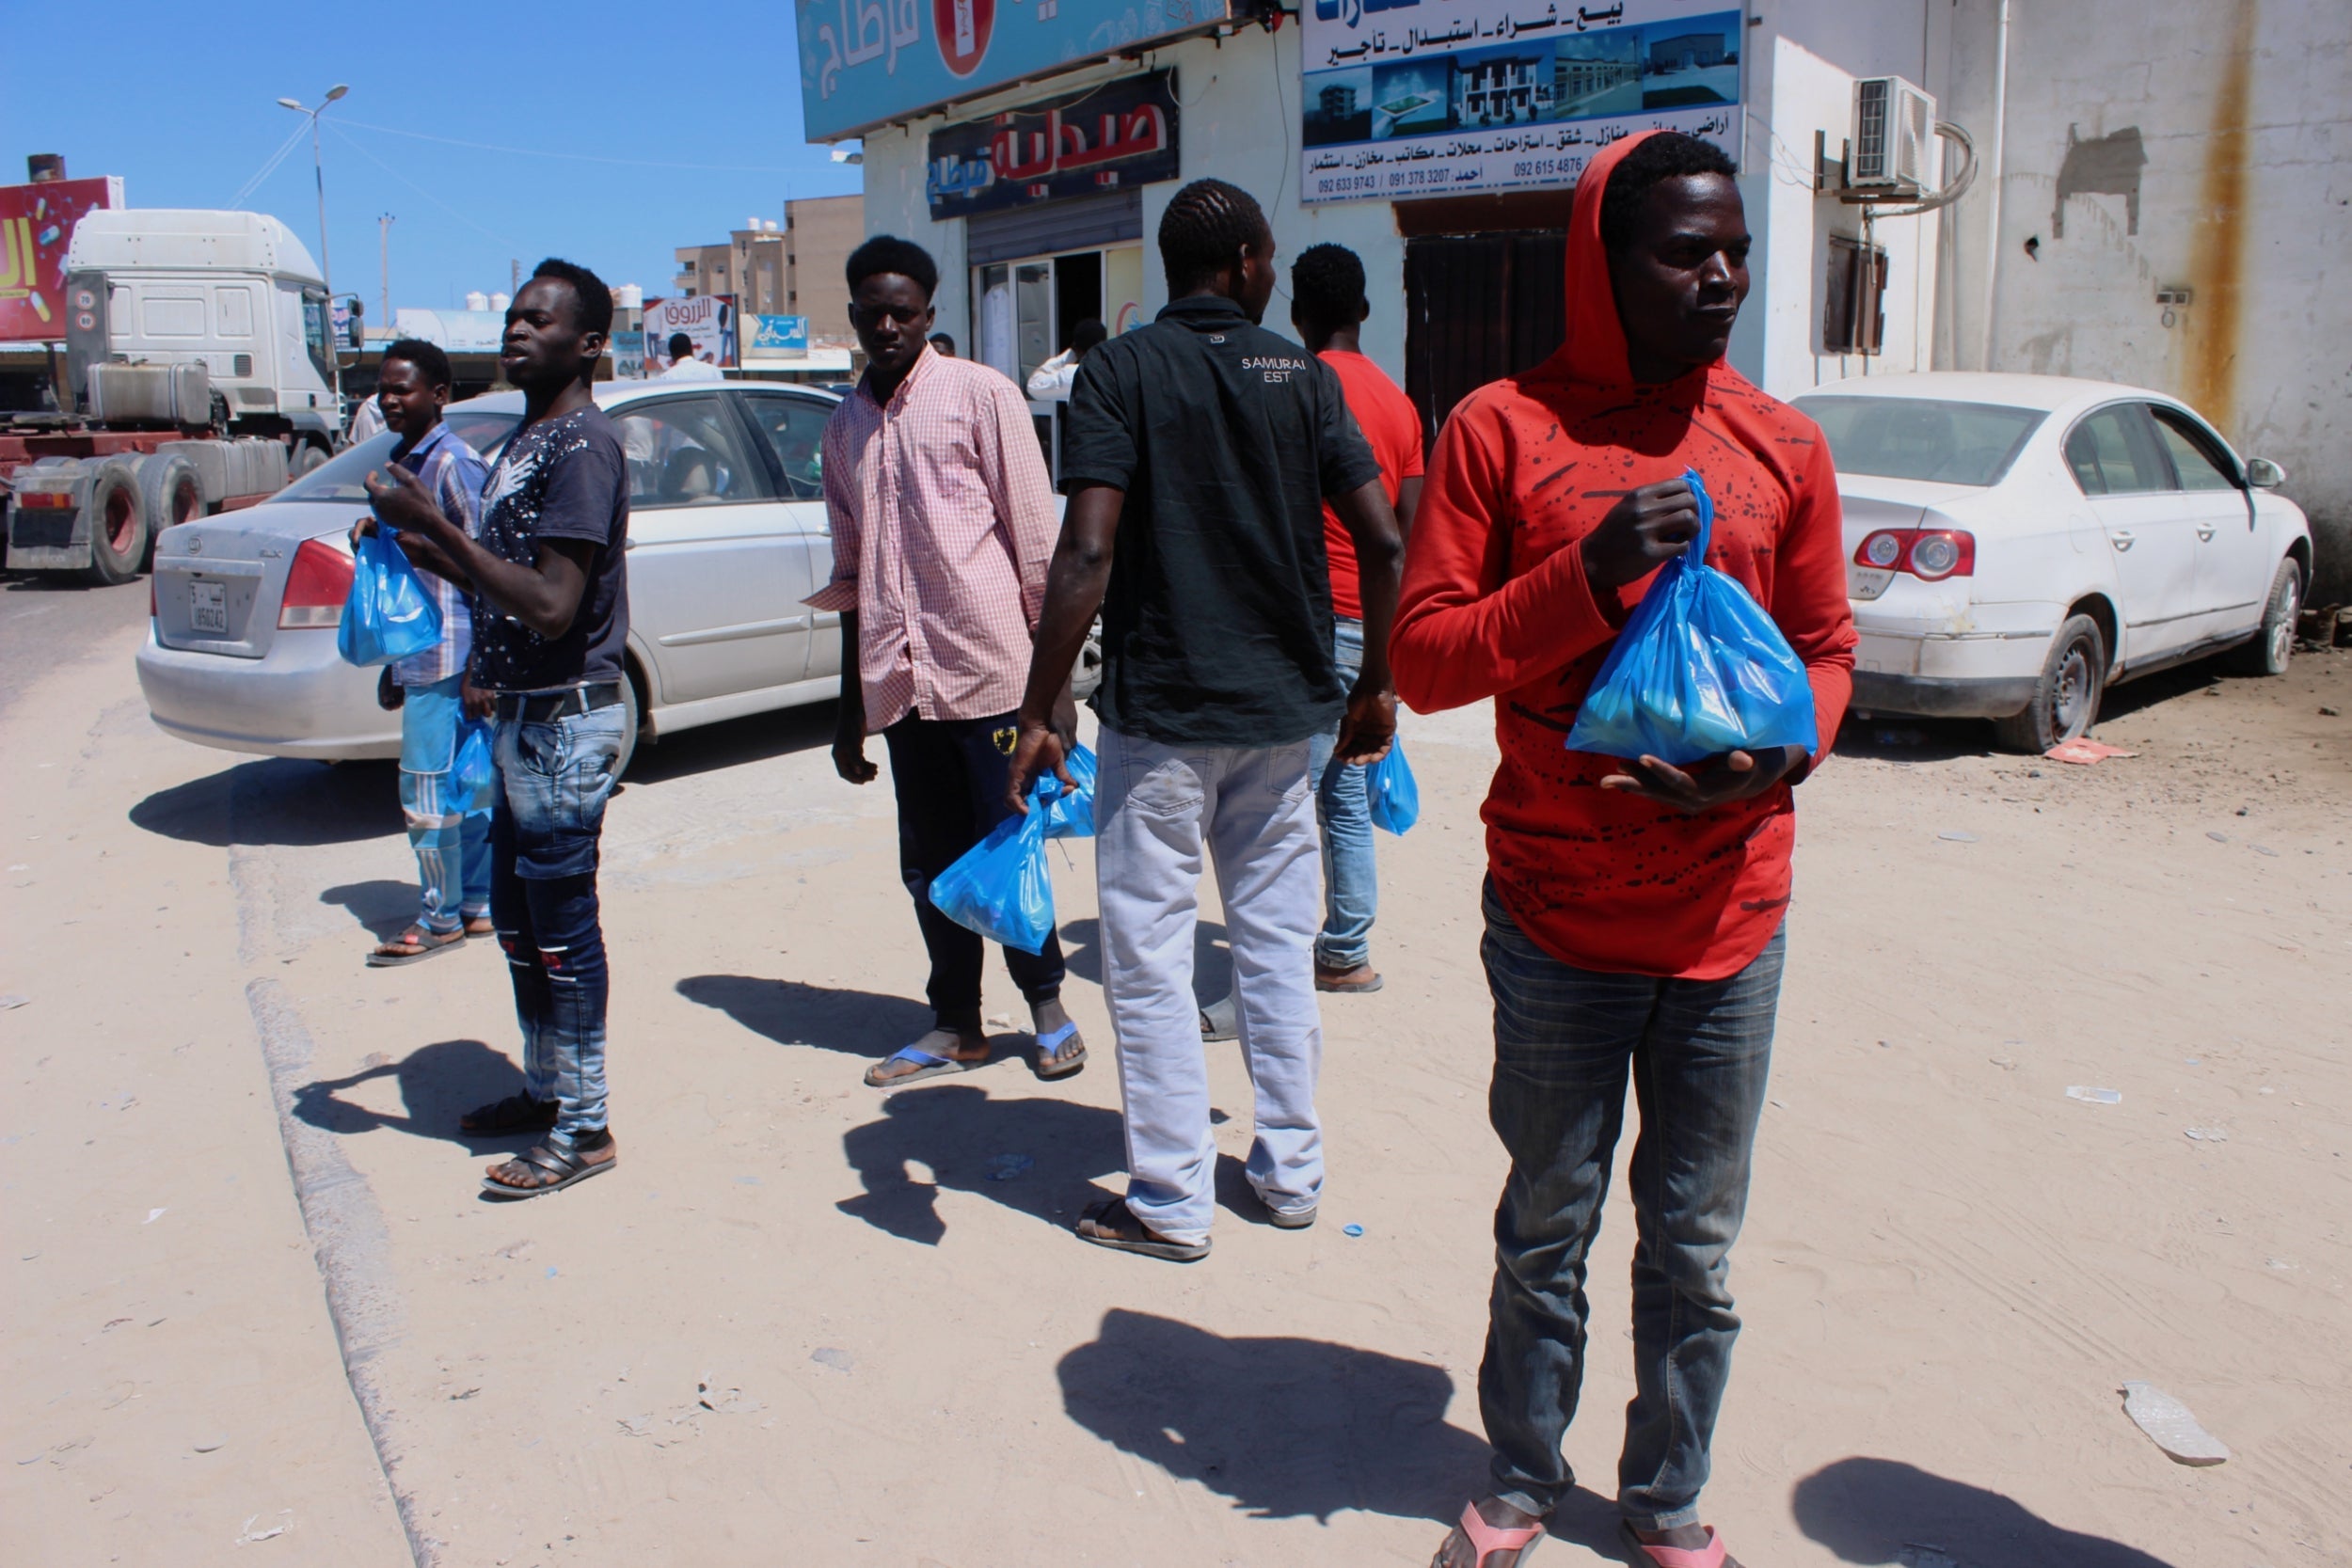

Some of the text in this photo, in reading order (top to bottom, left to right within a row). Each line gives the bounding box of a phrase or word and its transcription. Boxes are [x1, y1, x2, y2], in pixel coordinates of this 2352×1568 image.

[1327, 1, 1624, 66] بيع شراء استبدال تأجير
[1493, 134, 1544, 152] استراحات
[1556, 127, 1581, 150] شقق
[926, 103, 1167, 205] صيدلية قرطاج
[1395, 145, 1435, 166] مكاتب
[1446, 142, 1483, 157] محلات
[1309, 152, 1344, 174] استثمار
[1354, 150, 1384, 170] مخازن
[1514, 157, 1582, 177] 092 615 4876
[1354, 175, 1375, 189] 9743
[1389, 172, 1405, 186] 091
[1408, 170, 1424, 184] 378
[1428, 168, 1450, 183] 3207
[1318, 180, 1334, 193] 092
[1336, 178, 1352, 192] 633
[664, 298, 712, 325] الزروق
[1241, 356, 1307, 371] SAMURAI
[1263, 371, 1292, 383] EST
